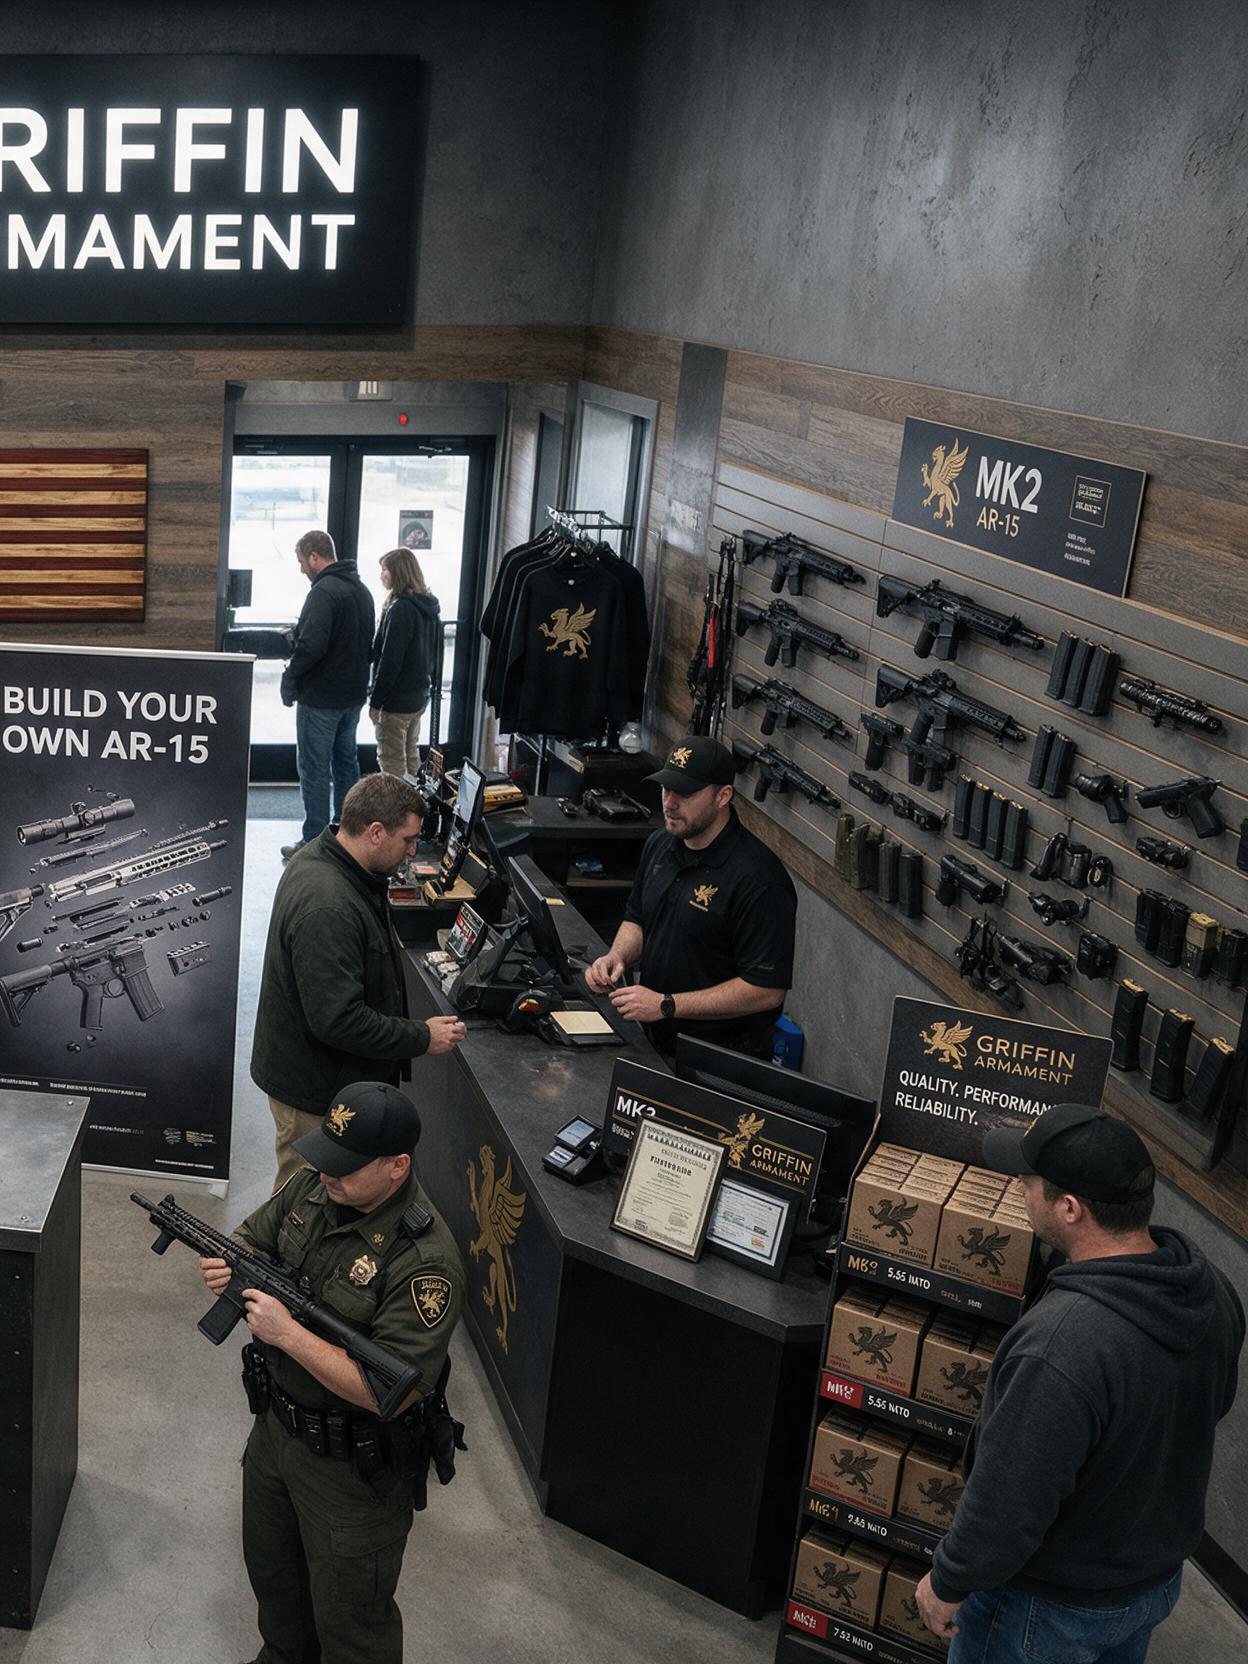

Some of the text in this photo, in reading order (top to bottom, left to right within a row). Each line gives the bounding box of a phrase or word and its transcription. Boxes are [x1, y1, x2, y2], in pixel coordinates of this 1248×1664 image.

[975, 455, 1042, 514] MK2
[976, 507, 1020, 538] AR-15
[4, 686, 218, 724] BUILD YOUR
[2, 725, 209, 764] OWN AR-15
[977, 1035, 1076, 1070] GRIFFIN
[974, 1055, 1073, 1086] ARMAMENT
[895, 1091, 979, 1126] RELIABILITY.
[900, 1070, 1057, 1117] QUALITY. PERFORMAN
[752, 1144, 813, 1175] GRIFFIN
